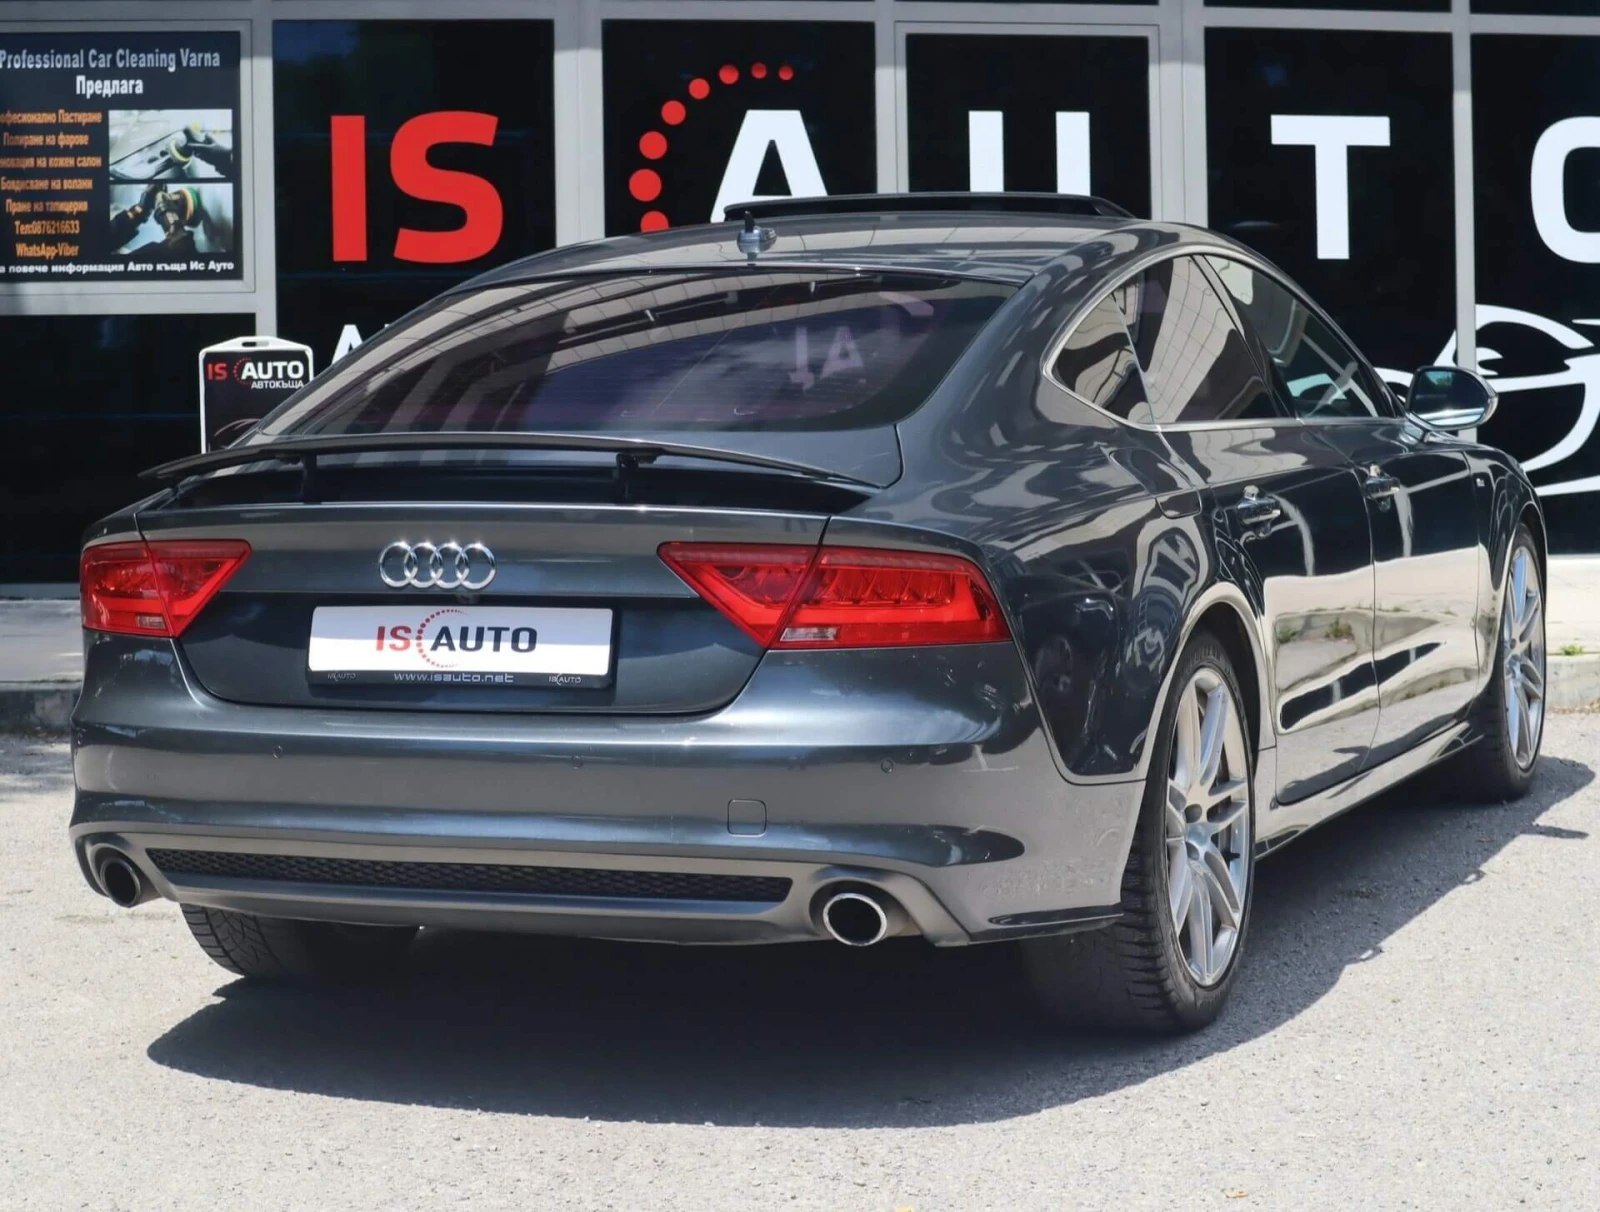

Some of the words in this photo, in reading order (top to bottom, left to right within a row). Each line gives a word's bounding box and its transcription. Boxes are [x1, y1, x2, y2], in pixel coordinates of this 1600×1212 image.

[0, 49, 84, 69] Professional
[88, 49, 112, 69] Car
[116, 48, 176, 72] Cleaning
[180, 47, 220, 67] Varna
[76, 74, 144, 99] Предлага
[330, 110, 504, 264] IS
[8, 264, 49, 274] повече
[51, 261, 125, 275] информация
[127, 261, 154, 272] Авто
[156, 262, 187, 273] къща
[189, 260, 206, 271] Ис
[207, 260, 235, 273] Ауто
[207, 363, 228, 381] IS
[241, 360, 304, 380] AUTO
[375, 625, 412, 653] IS
[430, 626, 538, 654] AUTO
[394, 672, 514, 684] www.isauto.net
